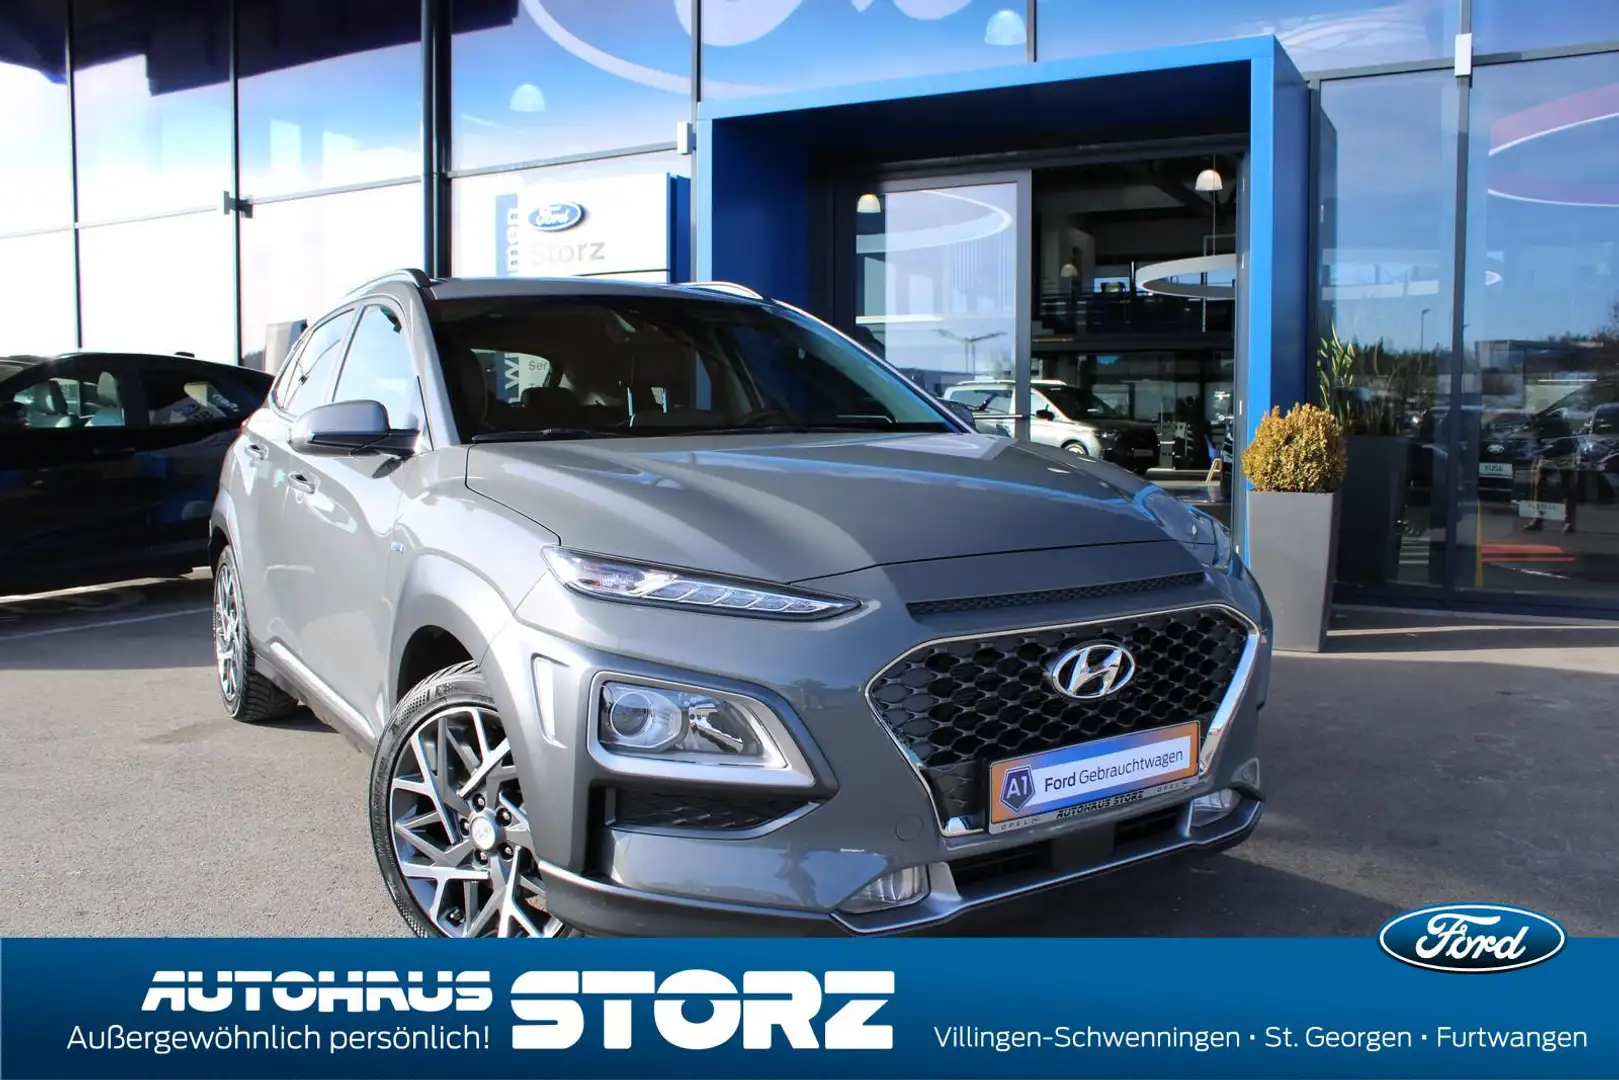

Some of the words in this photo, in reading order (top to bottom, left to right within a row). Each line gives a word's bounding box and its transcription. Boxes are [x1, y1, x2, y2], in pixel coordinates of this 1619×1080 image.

[532, 242, 605, 267] Storz
[1044, 772, 1076, 792] Ford
[1079, 750, 1183, 785] Gebrauchtwagen
[1005, 776, 1029, 799] A1
[1056, 798, 1110, 819] AUTOHAUS
[1113, 790, 1144, 806] STORZ
